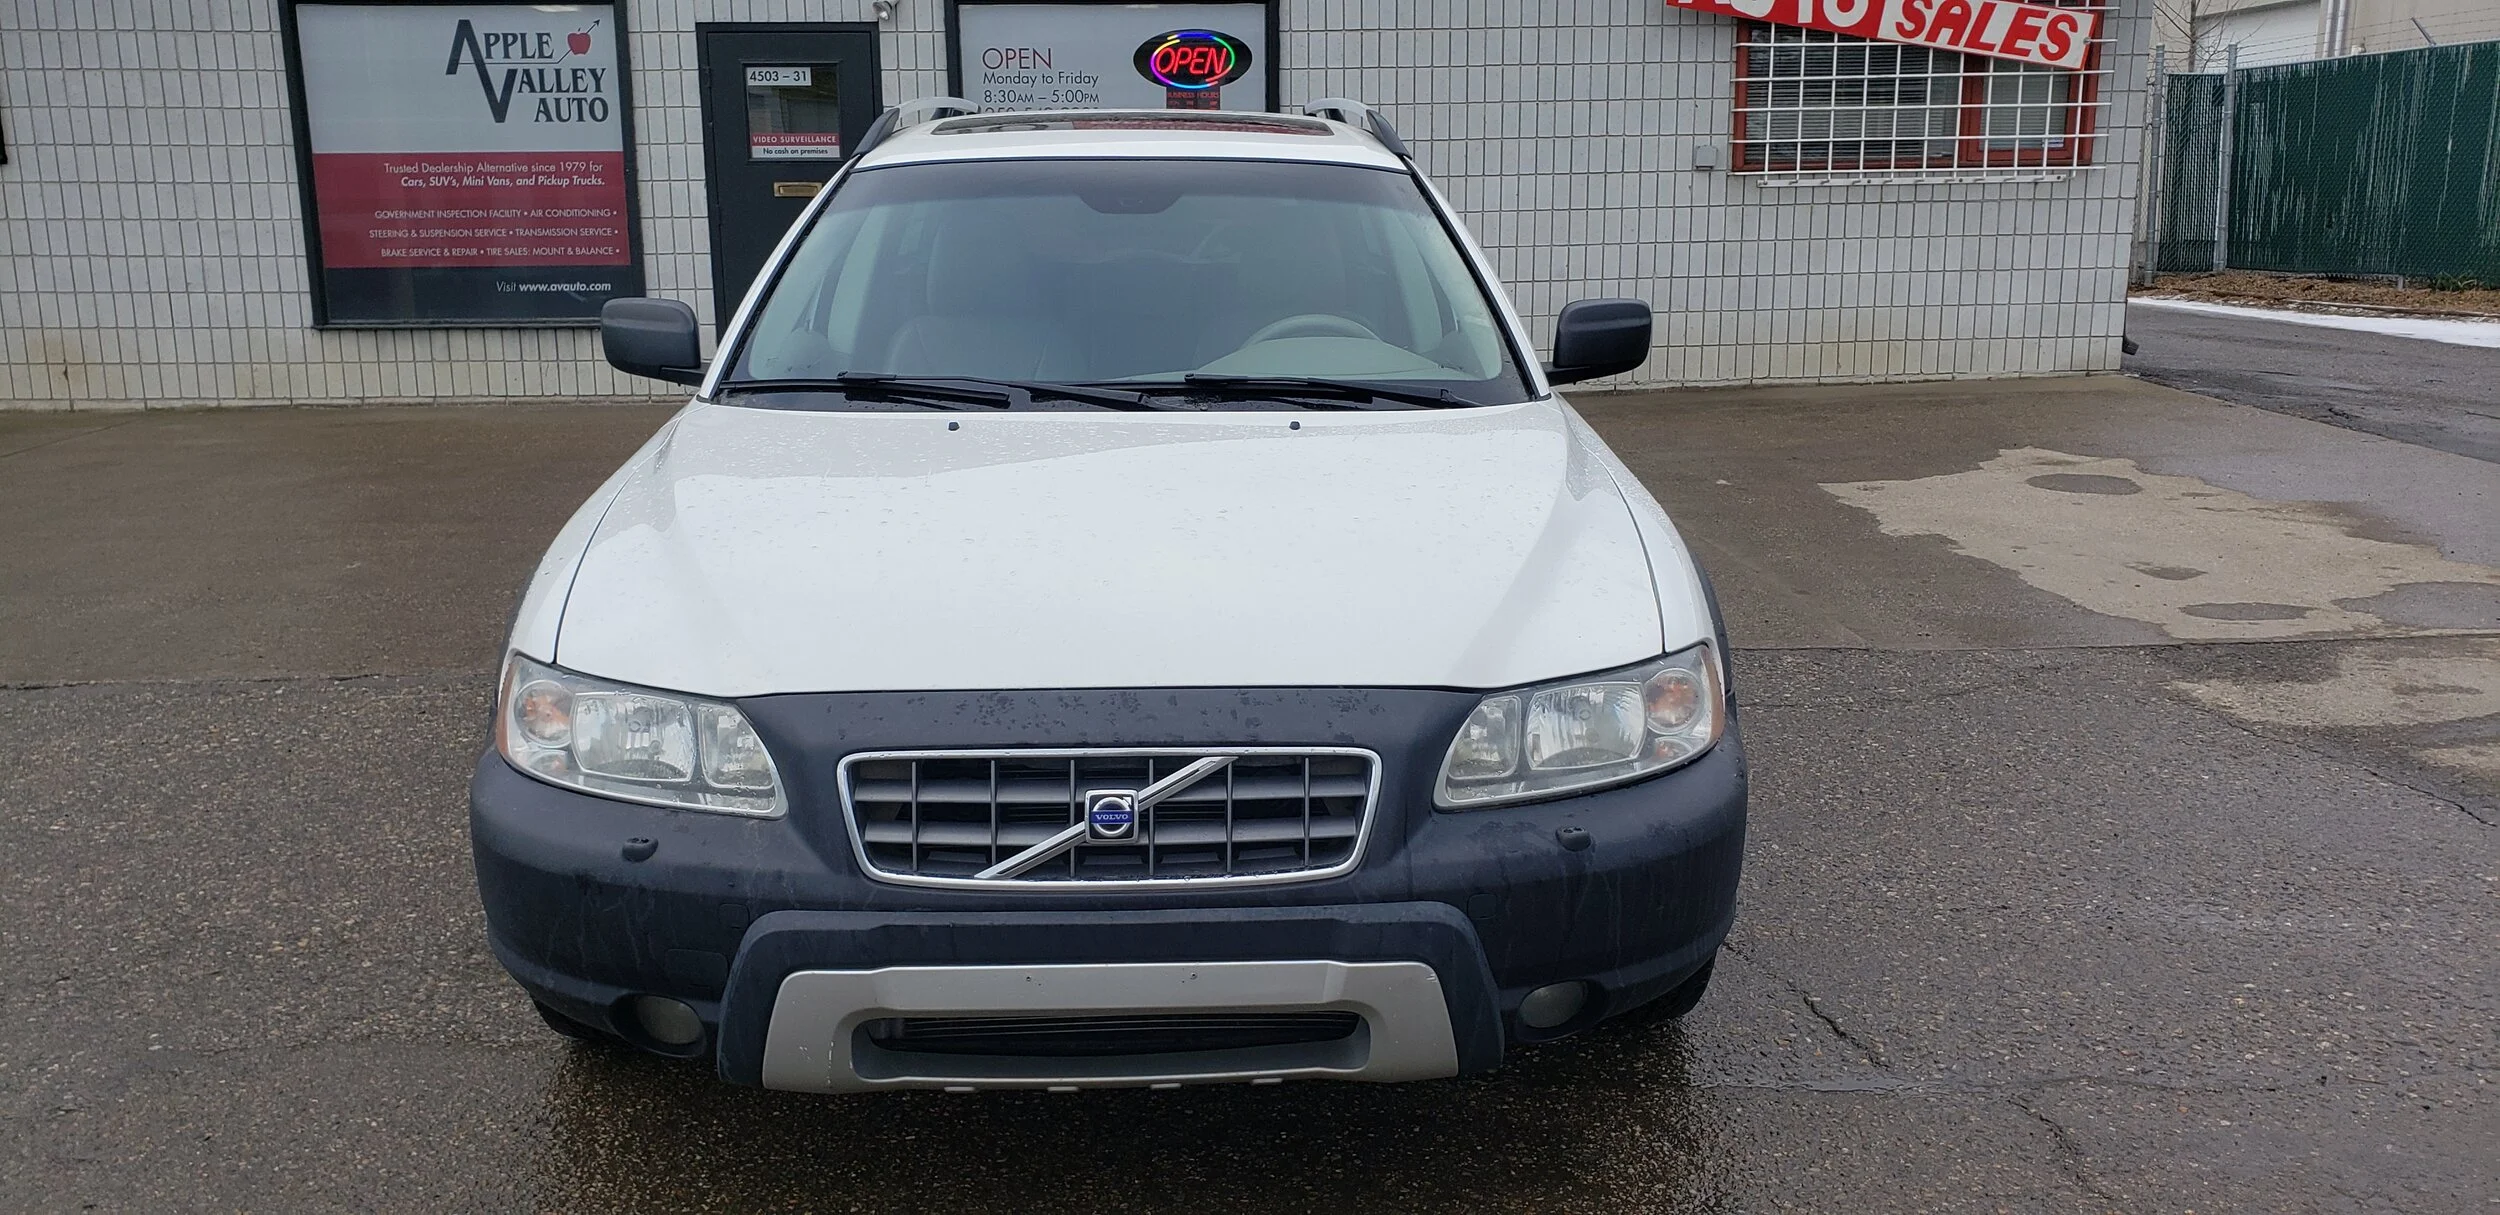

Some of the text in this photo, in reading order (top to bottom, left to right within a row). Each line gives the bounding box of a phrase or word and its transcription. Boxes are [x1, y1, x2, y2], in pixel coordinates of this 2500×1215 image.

[1895, 0, 2079, 61] SALES
[446, 19, 555, 76] APPLE
[982, 47, 1052, 70] OPEN
[1155, 47, 1227, 75] OPEN
[749, 70, 779, 82] 4503
[793, 70, 807, 82] 31
[983, 70, 1099, 88] Monday to Friday
[480, 67, 607, 123] VALLEY
[984, 89, 1034, 104] 8:30AM
[1051, 89, 1100, 104] 5:00PM
[534, 97, 609, 123] AUTO
[752, 135, 837, 144] VIDEO SURVEILLANCE
[763, 147, 773, 155] No
[774, 147, 790, 155] cash
[800, 147, 829, 156] premises
[384, 160, 603, 175] Trusted Dealership Alternative since 1979 for
[401, 176, 426, 188] Cars,
[462, 175, 484, 187] Mini
[487, 175, 513, 187] Vans,
[516, 174, 536, 186] and
[538, 174, 569, 188] Pickup
[572, 174, 605, 186] Trucks.
[375, 208, 611, 219] GOVERNMENT INSPECTION FACILITY AIR CONDITIONING
[369, 227, 612, 239] STEERING & SUSPENSION SERVICE TRANSMISSION SERVICE
[381, 248, 408, 257] BRAKE
[409, 248, 442, 257] SERVICE
[443, 247, 450, 257] &
[452, 247, 478, 256] REPAIR
[486, 247, 502, 256] TIRE
[532, 246, 565, 256] MOUNT
[567, 246, 574, 256] &
[575, 246, 614, 255] BALANCE
[496, 280, 612, 292] Visit www.avauto.com
